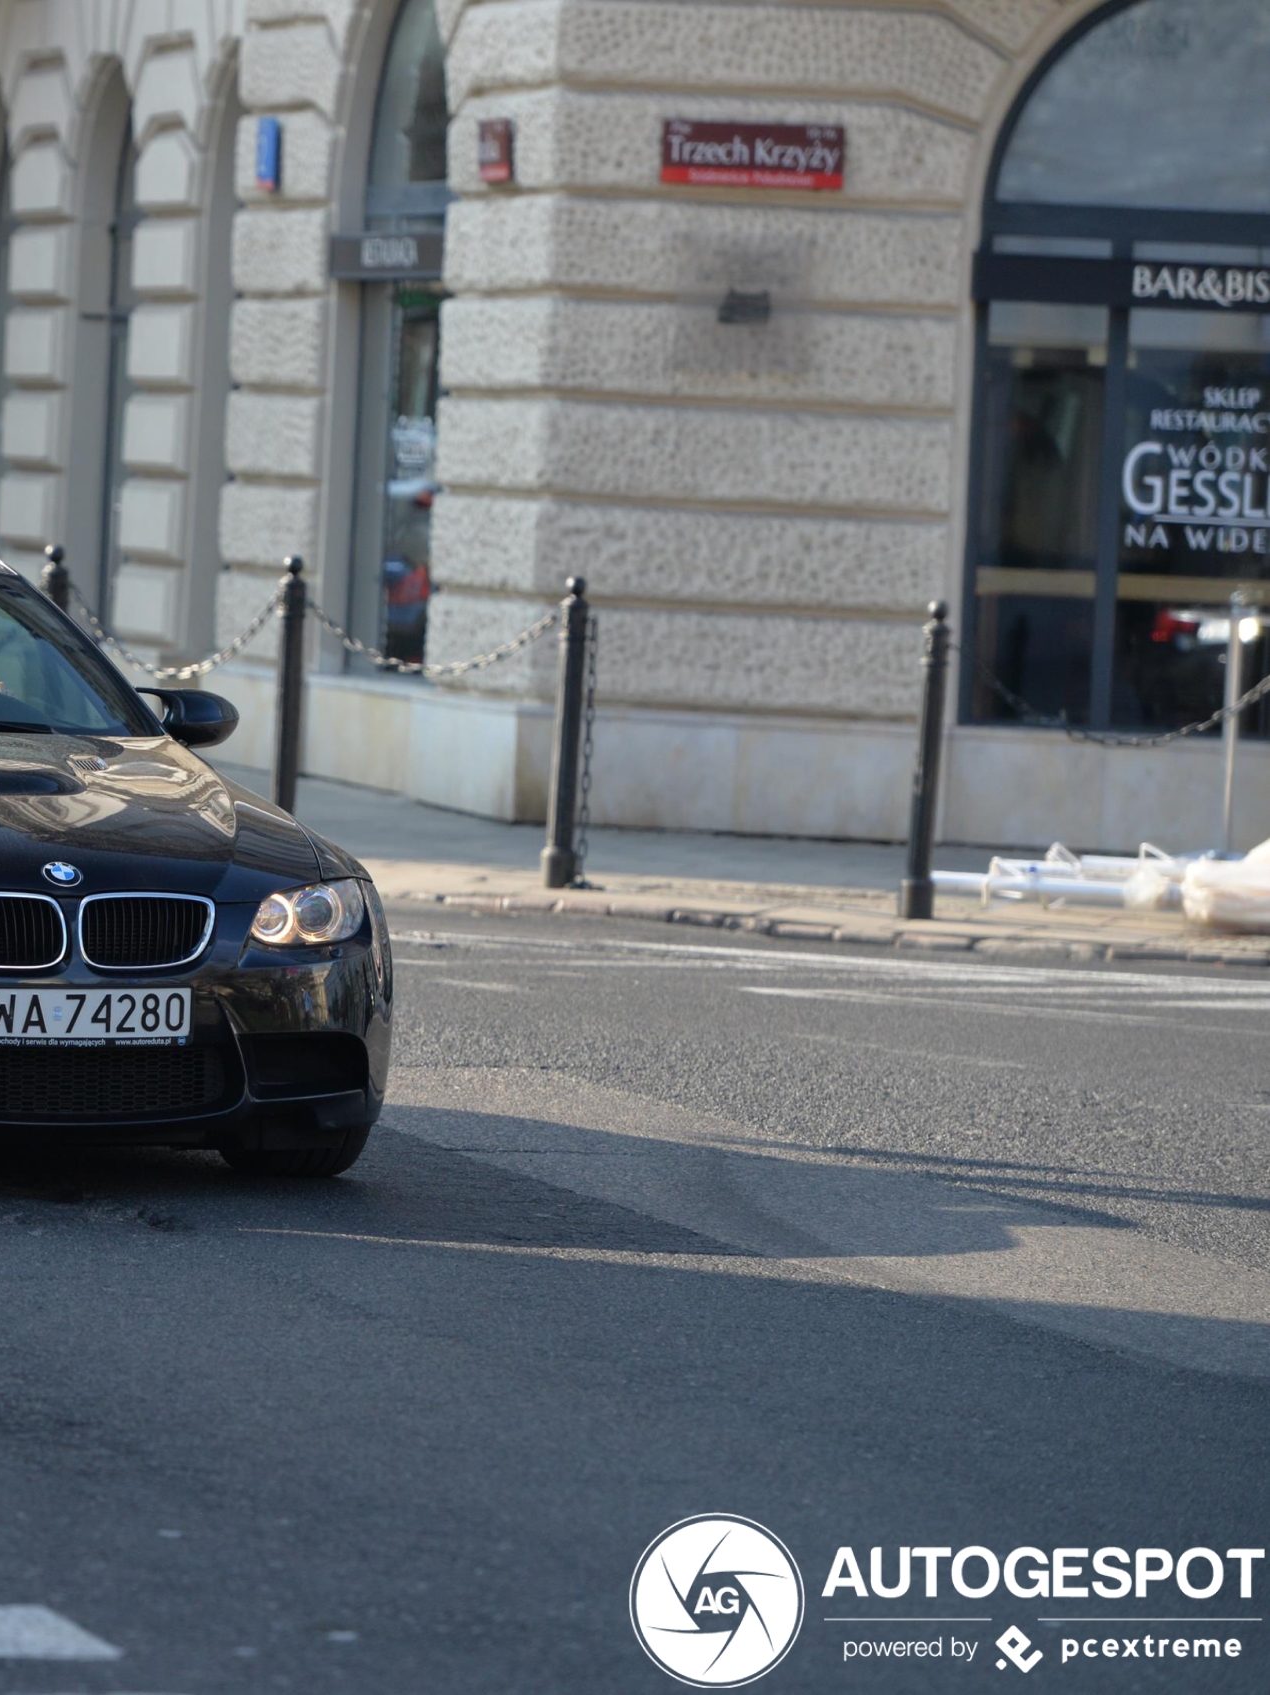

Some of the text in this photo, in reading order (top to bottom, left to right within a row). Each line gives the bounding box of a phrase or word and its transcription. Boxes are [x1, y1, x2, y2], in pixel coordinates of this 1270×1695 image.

[668, 134, 840, 176] Trzech Krzyży
[1203, 386, 1260, 409] SKLEP
[1150, 408, 1270, 433] RESTAURAC
[1166, 440, 1268, 472] WÓDK
[1122, 442, 1270, 519] GESSL
[1124, 523, 1267, 554] NA WIDE
[65, 993, 184, 1033] 74280
[26, 1038, 46, 1046] serwis
[49, 1038, 58, 1046] dla
[115, 1037, 171, 1046] www.autoreduta.pl
